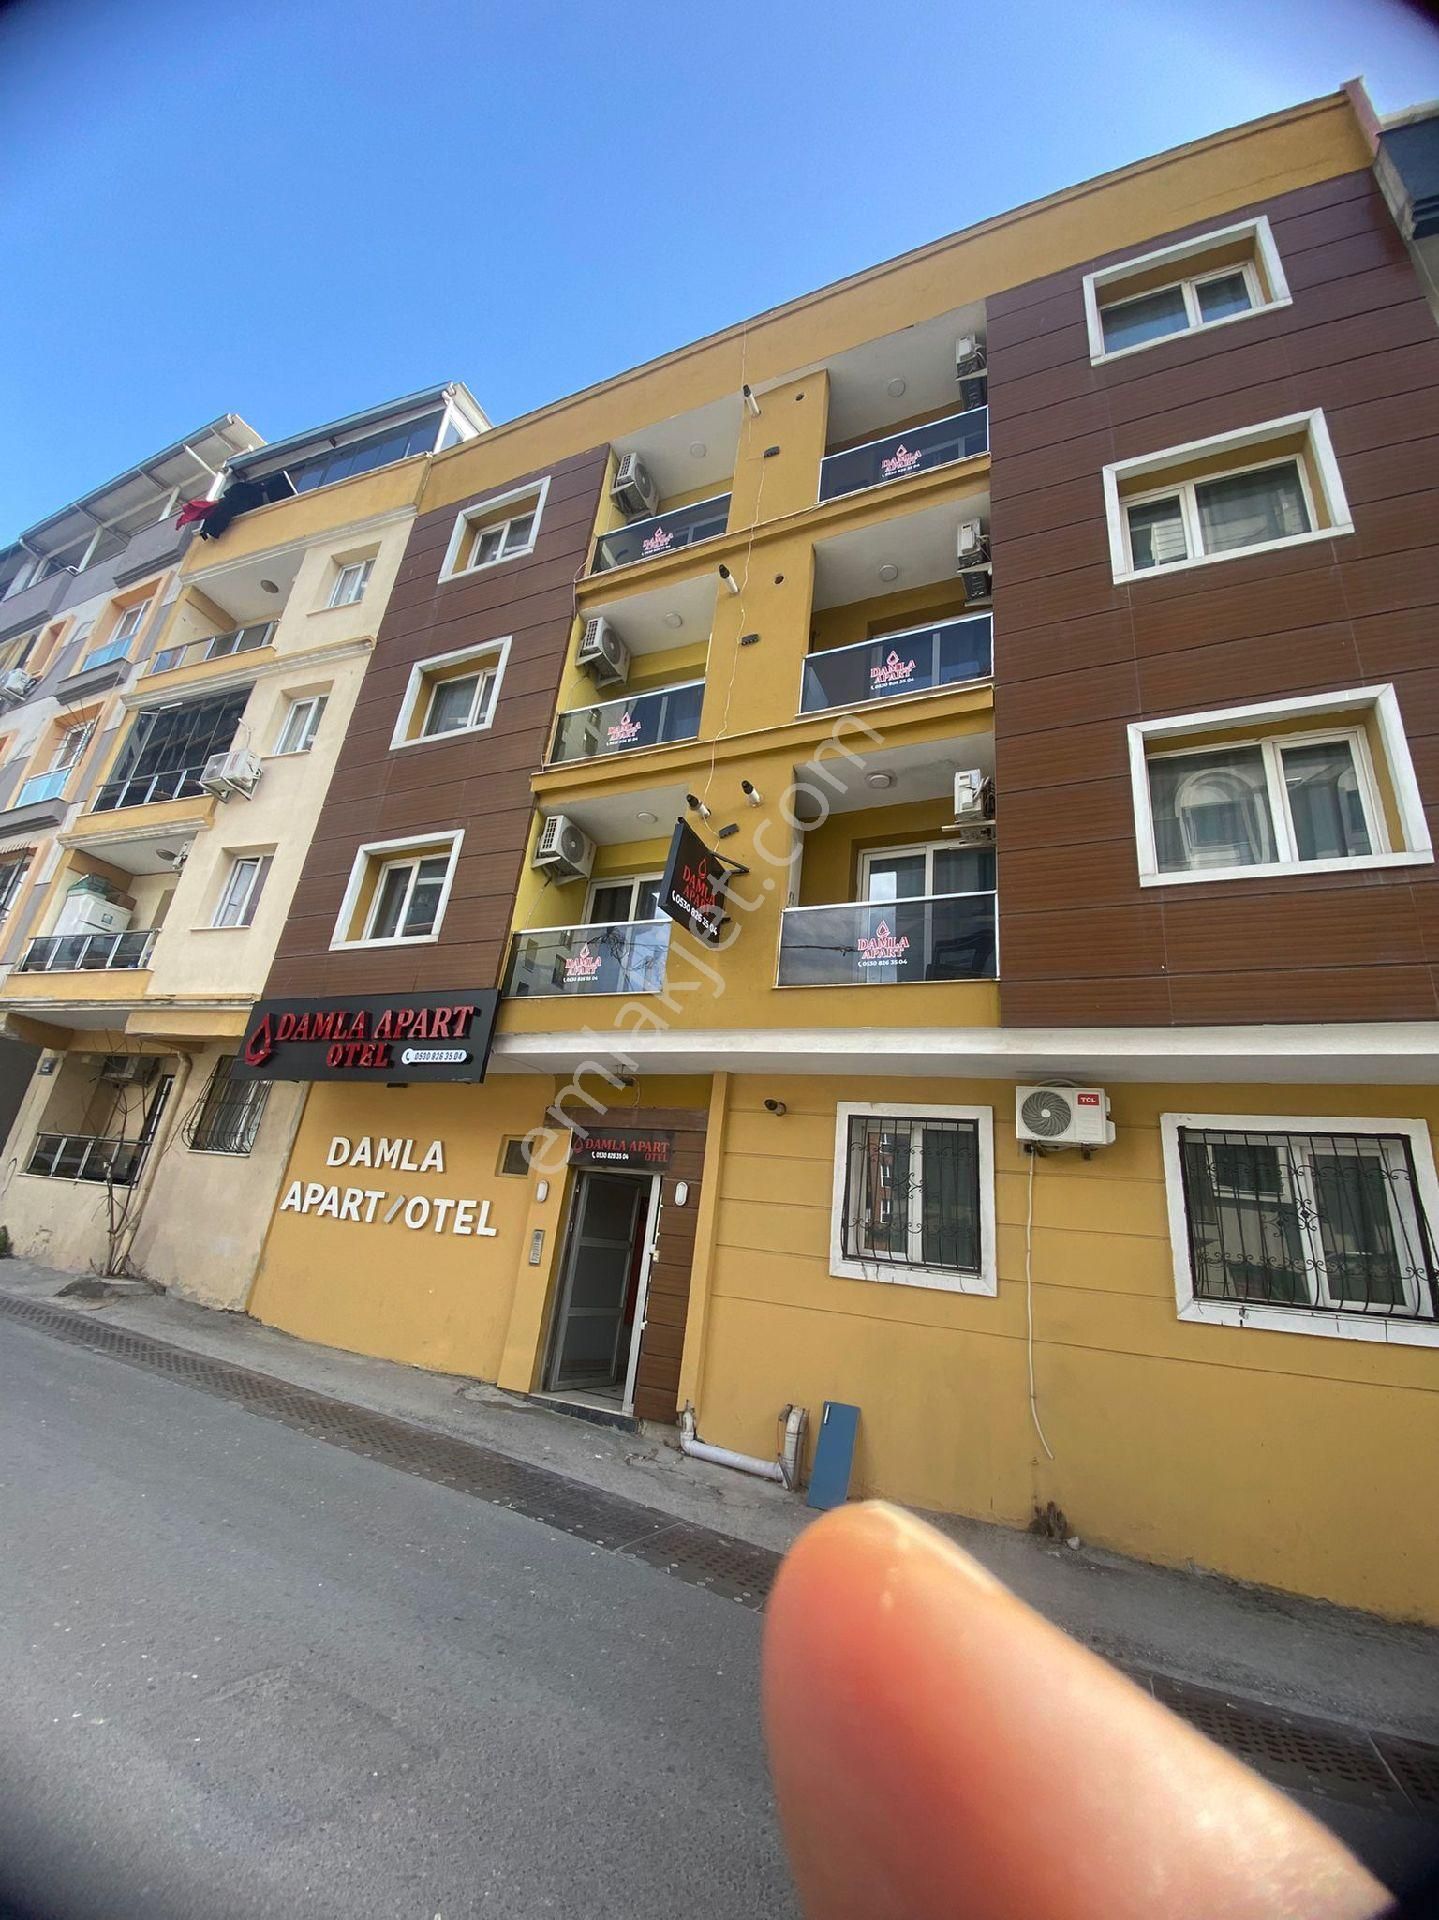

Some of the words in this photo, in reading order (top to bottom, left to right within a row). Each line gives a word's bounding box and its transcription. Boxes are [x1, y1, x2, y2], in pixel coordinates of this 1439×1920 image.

[870, 660, 916, 678] DAMLA
[682, 864, 716, 907] DAMLA
[675, 894, 691, 913] 0530
[690, 907, 703, 923] 826
[857, 936, 910, 951] DAMLA
[861, 948, 905, 960] APART
[275, 1010, 366, 1041] DAMLA
[372, 1004, 476, 1039] APART
[326, 1042, 392, 1068] OTEL
[326, 1136, 445, 1173] DAMLA
[585, 1138, 626, 1151] DAMLA
[630, 1140, 670, 1153] APART
[644, 1152, 668, 1162] OTEL
